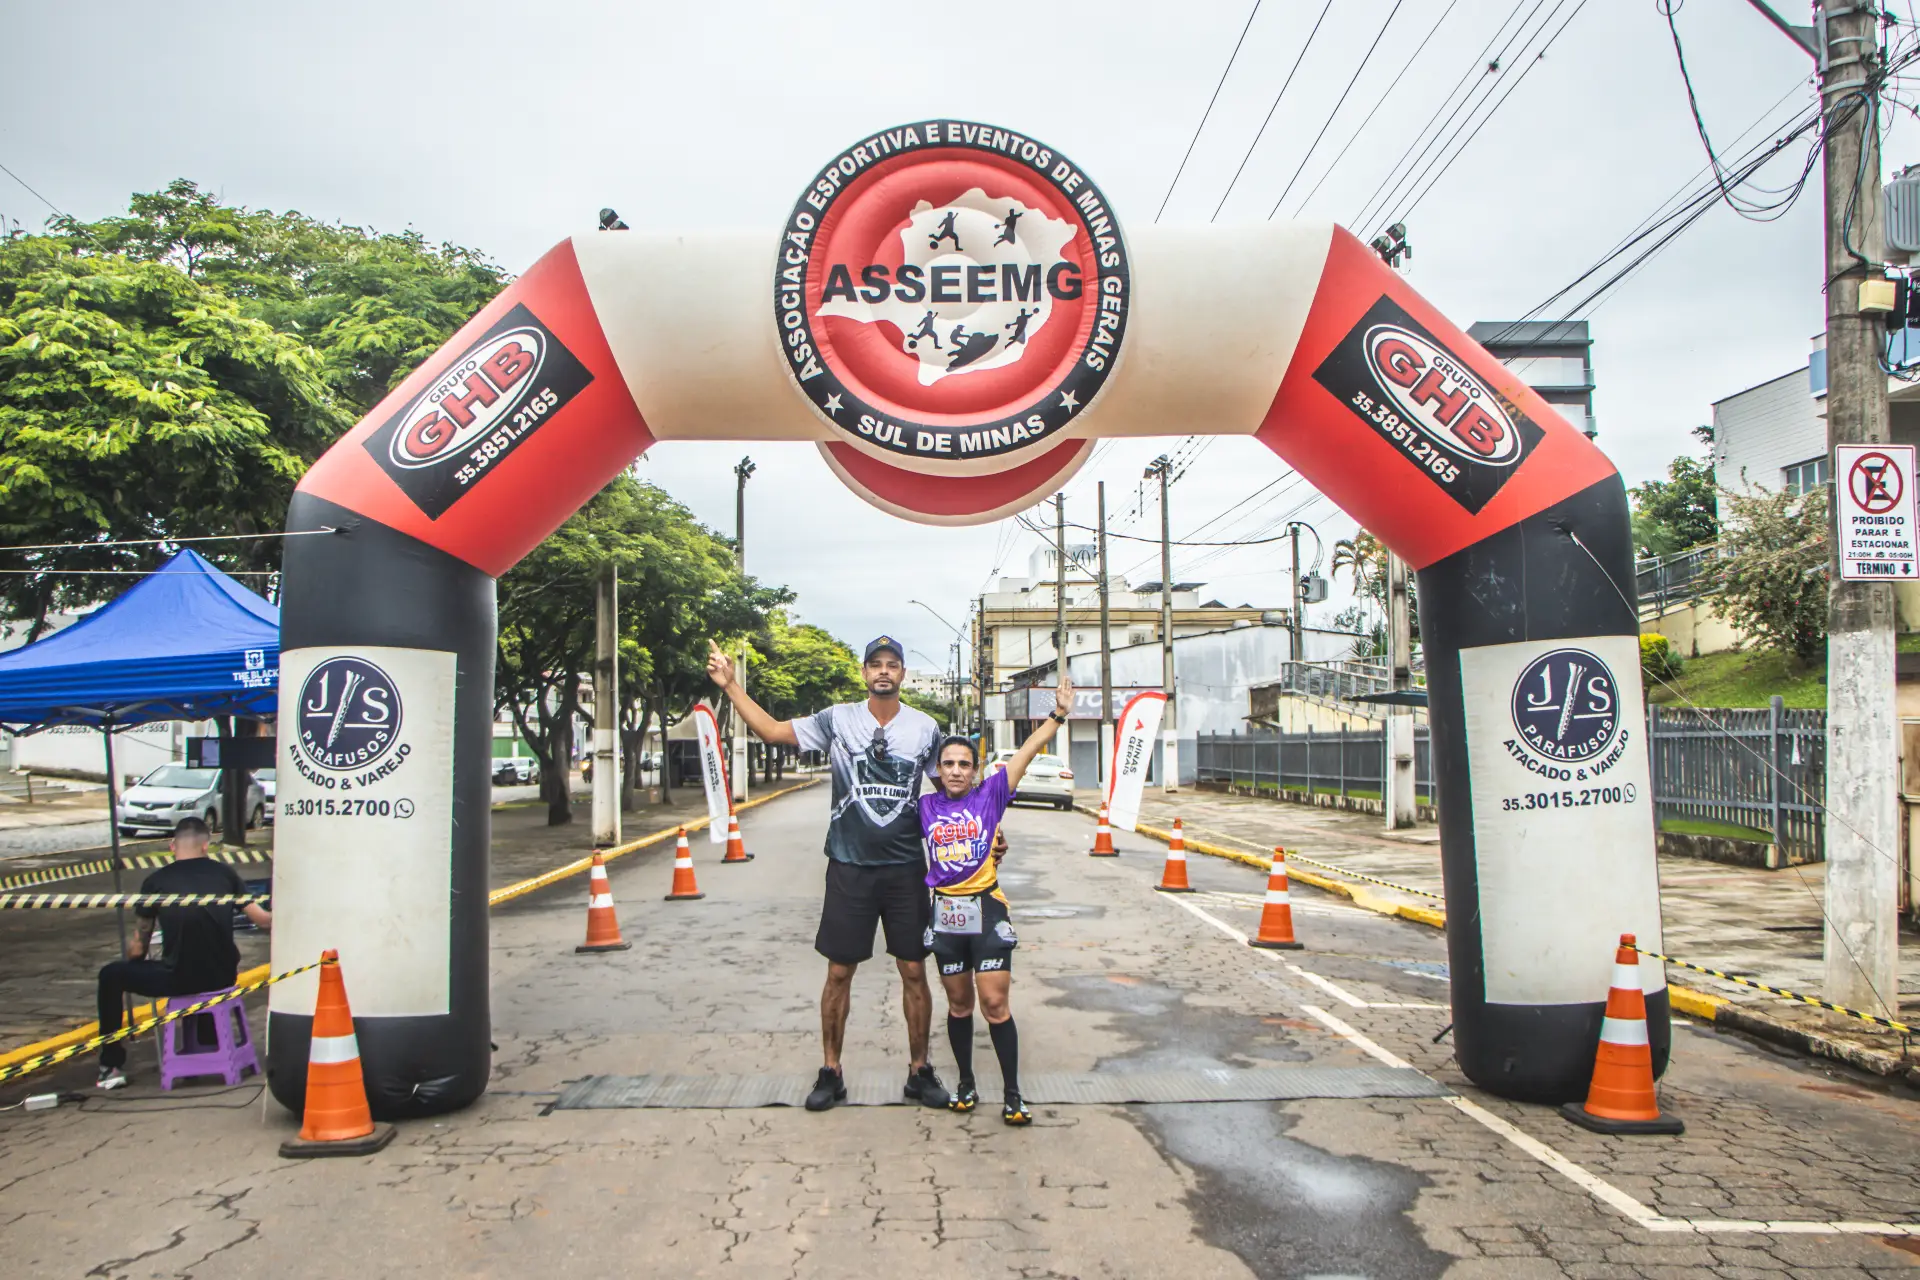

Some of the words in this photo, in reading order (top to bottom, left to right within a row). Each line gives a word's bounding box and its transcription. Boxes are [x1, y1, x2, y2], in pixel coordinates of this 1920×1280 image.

[925, 123, 941, 143] E
[948, 123, 1053, 169] EVENTOS
[808, 127, 921, 212] ESPORTIVA
[1050, 160, 1084, 194] DE
[1076, 188, 1120, 270] MINAS
[782, 213, 824, 383] ASSOCIAÇÃO
[821, 261, 1083, 304] ASSEEMG
[1085, 275, 1123, 372] GERAIS
[429, 360, 477, 404] GRUPO
[1374, 338, 1505, 457] GHB
[1432, 355, 1482, 400] GRUPO
[404, 341, 536, 459] GHB
[454, 387, 559, 486] 35.3851.2165
[857, 413, 908, 448] SUL
[916, 431, 952, 453] DE
[959, 413, 1046, 453] MINAS
[1351, 391, 1461, 484] 35.3851.2165
[1852, 516, 1905, 525] PROIBIDO
[1855, 528, 1889, 536] PARAR
[1851, 540, 1909, 548] ESTACIONAR
[232, 671, 250, 681] THE
[1587, 676, 1611, 712] S
[361, 686, 390, 723] S
[302, 730, 388, 766] PARAFUSOS
[1123, 736, 1137, 776] GERAIS
[1130, 738, 1144, 774] MINAS
[1503, 738, 1572, 782] ATACADO
[1576, 769, 1588, 781] &
[1589, 729, 1629, 776] VAREJO
[1524, 719, 1613, 758] PARAFUSOS
[289, 744, 336, 790] ATACADO
[340, 778, 352, 790] &
[356, 743, 412, 788] VAREJO
[284, 799, 390, 817] 35.3015.2700
[1502, 786, 1621, 811] 35.3015.2700
[941, 912, 966, 927] 349
